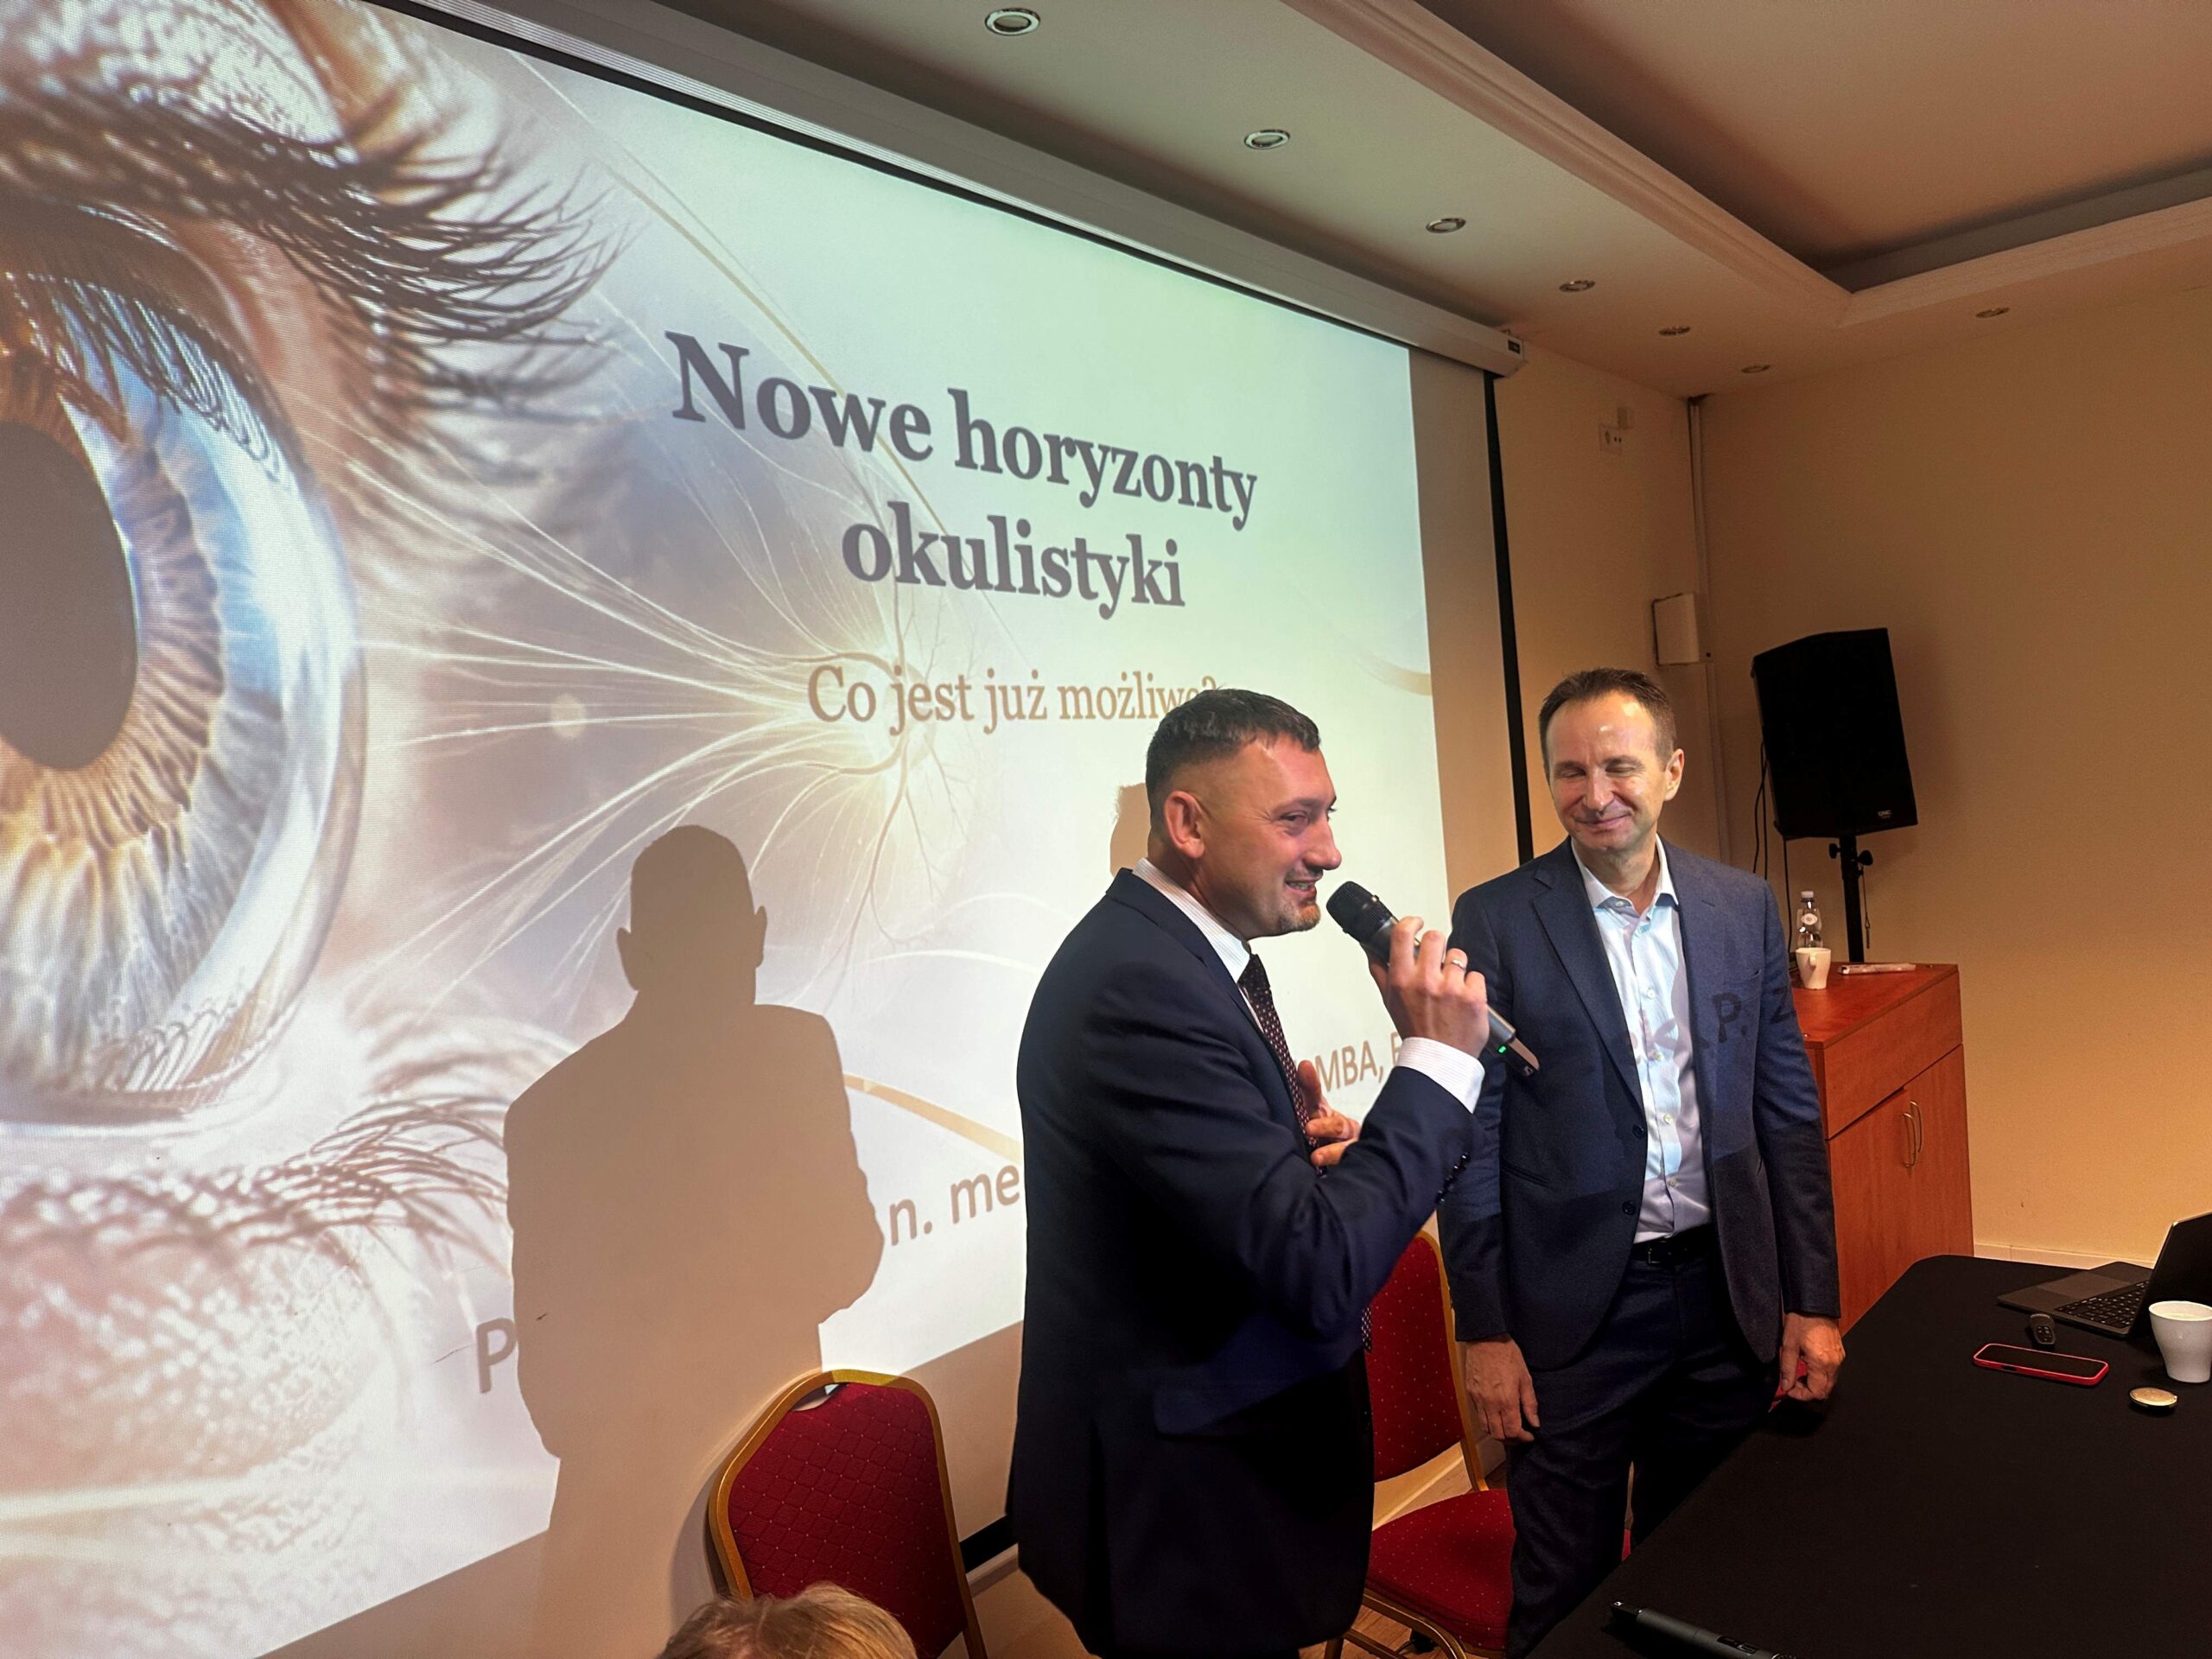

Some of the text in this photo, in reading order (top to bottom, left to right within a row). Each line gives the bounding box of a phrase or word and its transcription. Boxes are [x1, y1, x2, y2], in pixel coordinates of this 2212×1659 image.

[664, 329, 1258, 531] Nowe horyzonty
[841, 499, 1185, 620] okulistyki
[808, 664, 876, 723] Co
[889, 664, 976, 737] jest
[983, 667, 1048, 735] już
[1314, 1039, 1384, 1093] MBA,
